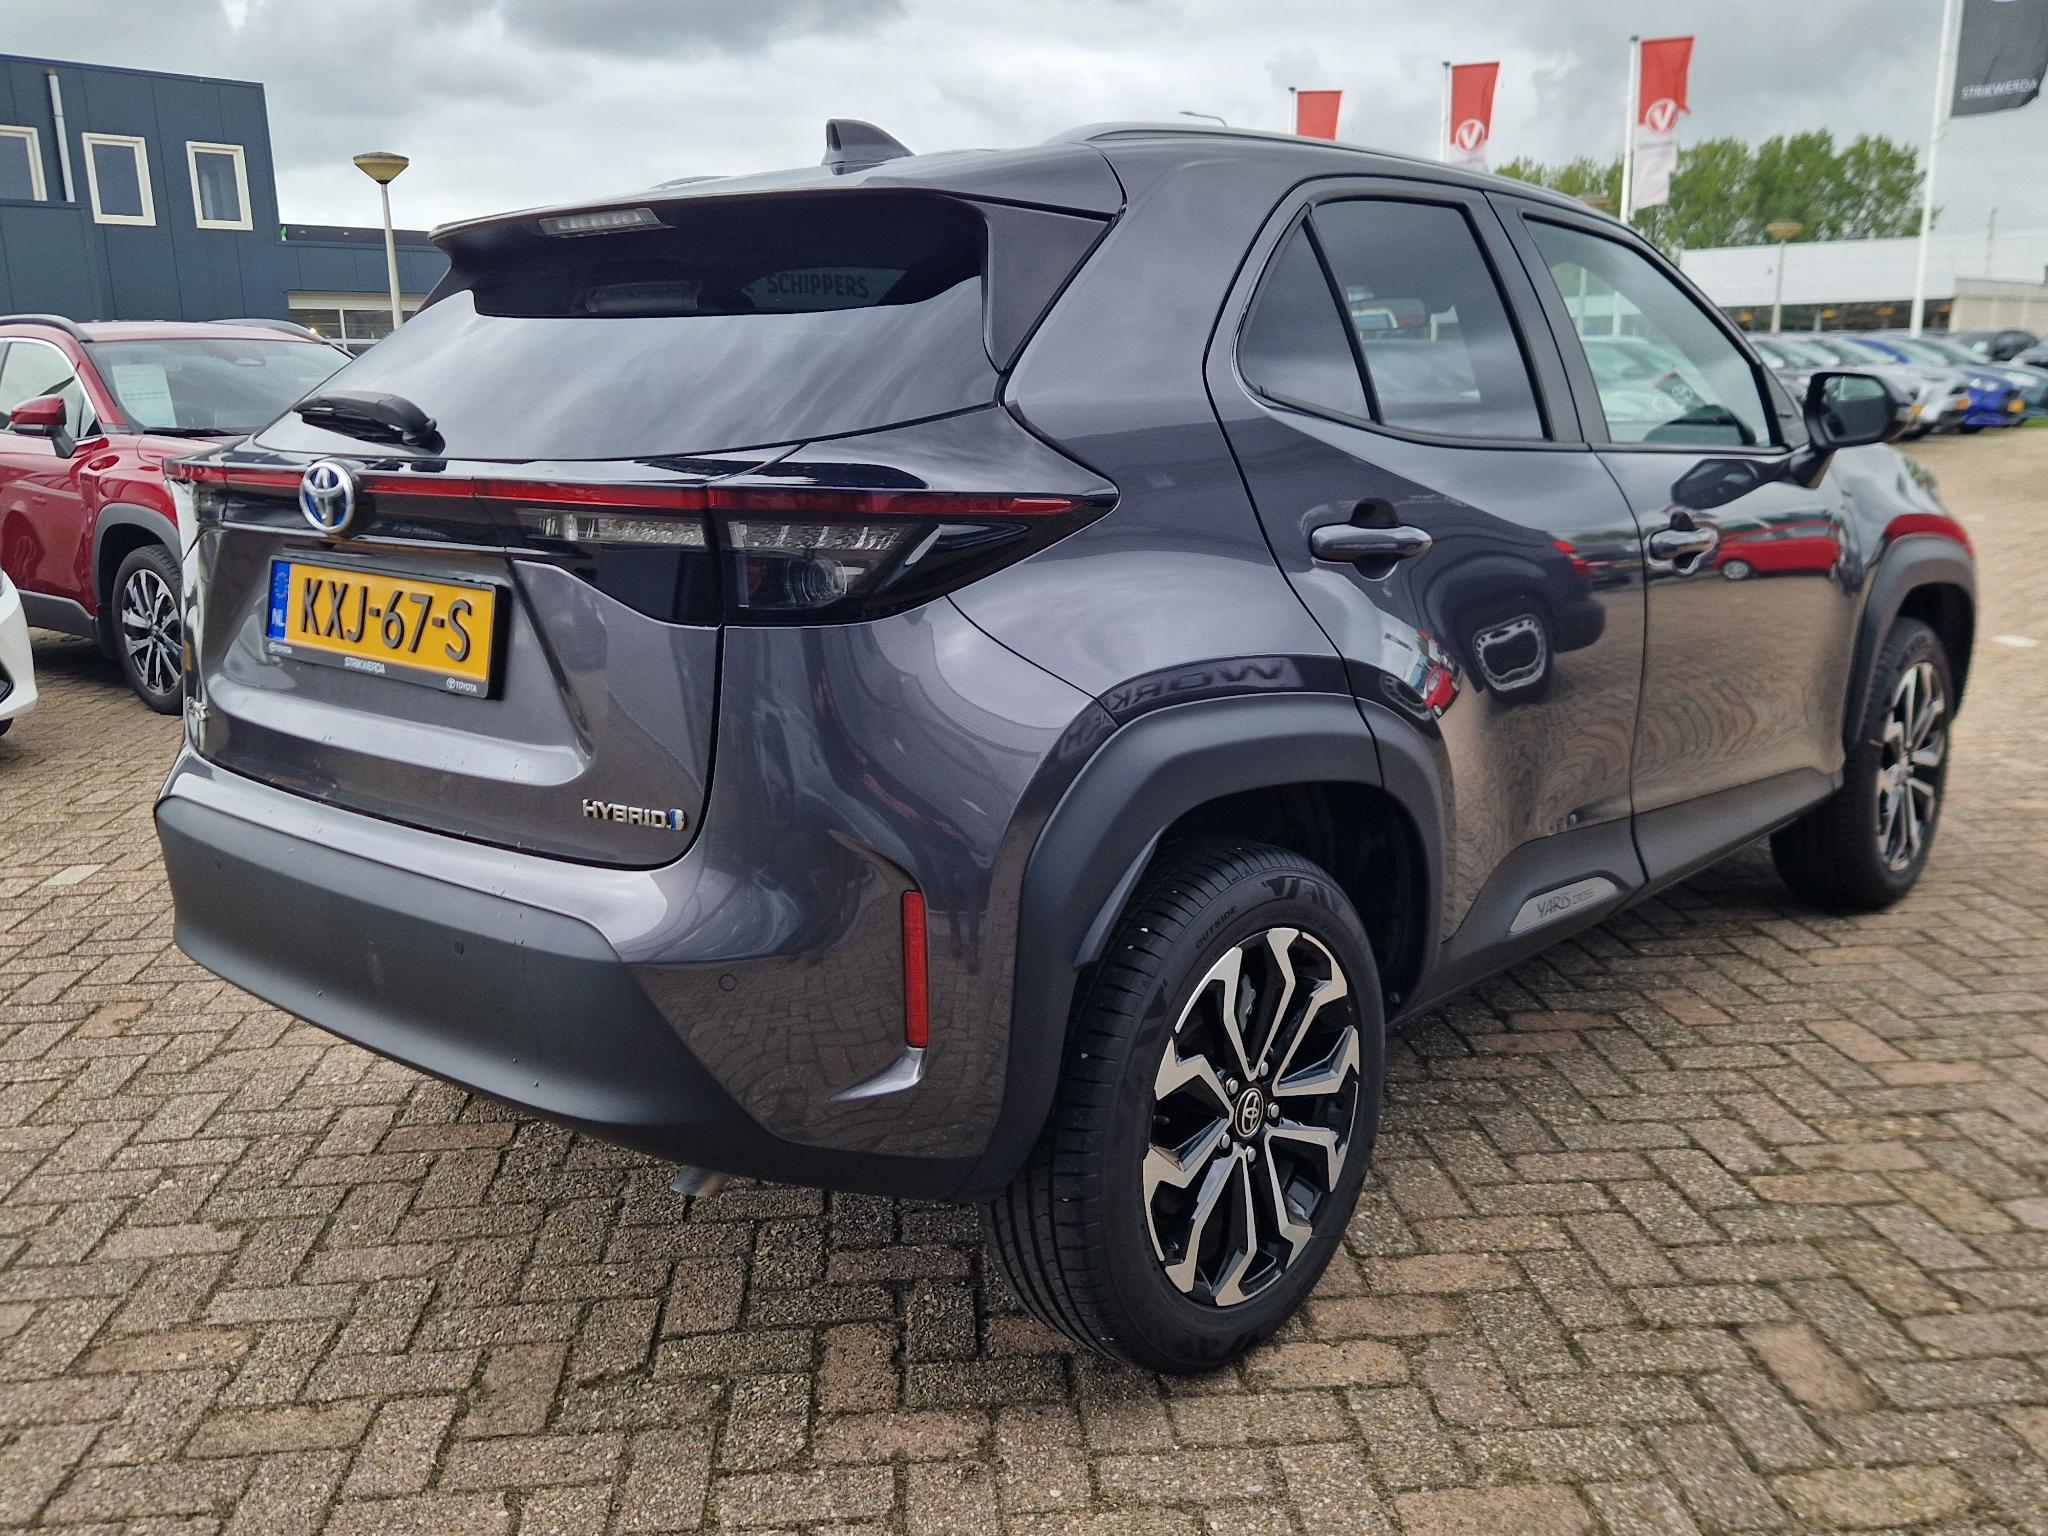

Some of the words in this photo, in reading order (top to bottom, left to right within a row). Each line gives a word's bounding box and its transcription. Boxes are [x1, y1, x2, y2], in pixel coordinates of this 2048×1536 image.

[766, 273, 869, 298] SCHIPPERS
[271, 608, 285, 628] NL
[301, 577, 473, 663] KXJ-67-S
[455, 680, 478, 693] TOYOTA
[582, 799, 667, 829] HYBRID
[1537, 892, 1571, 918] YARIS
